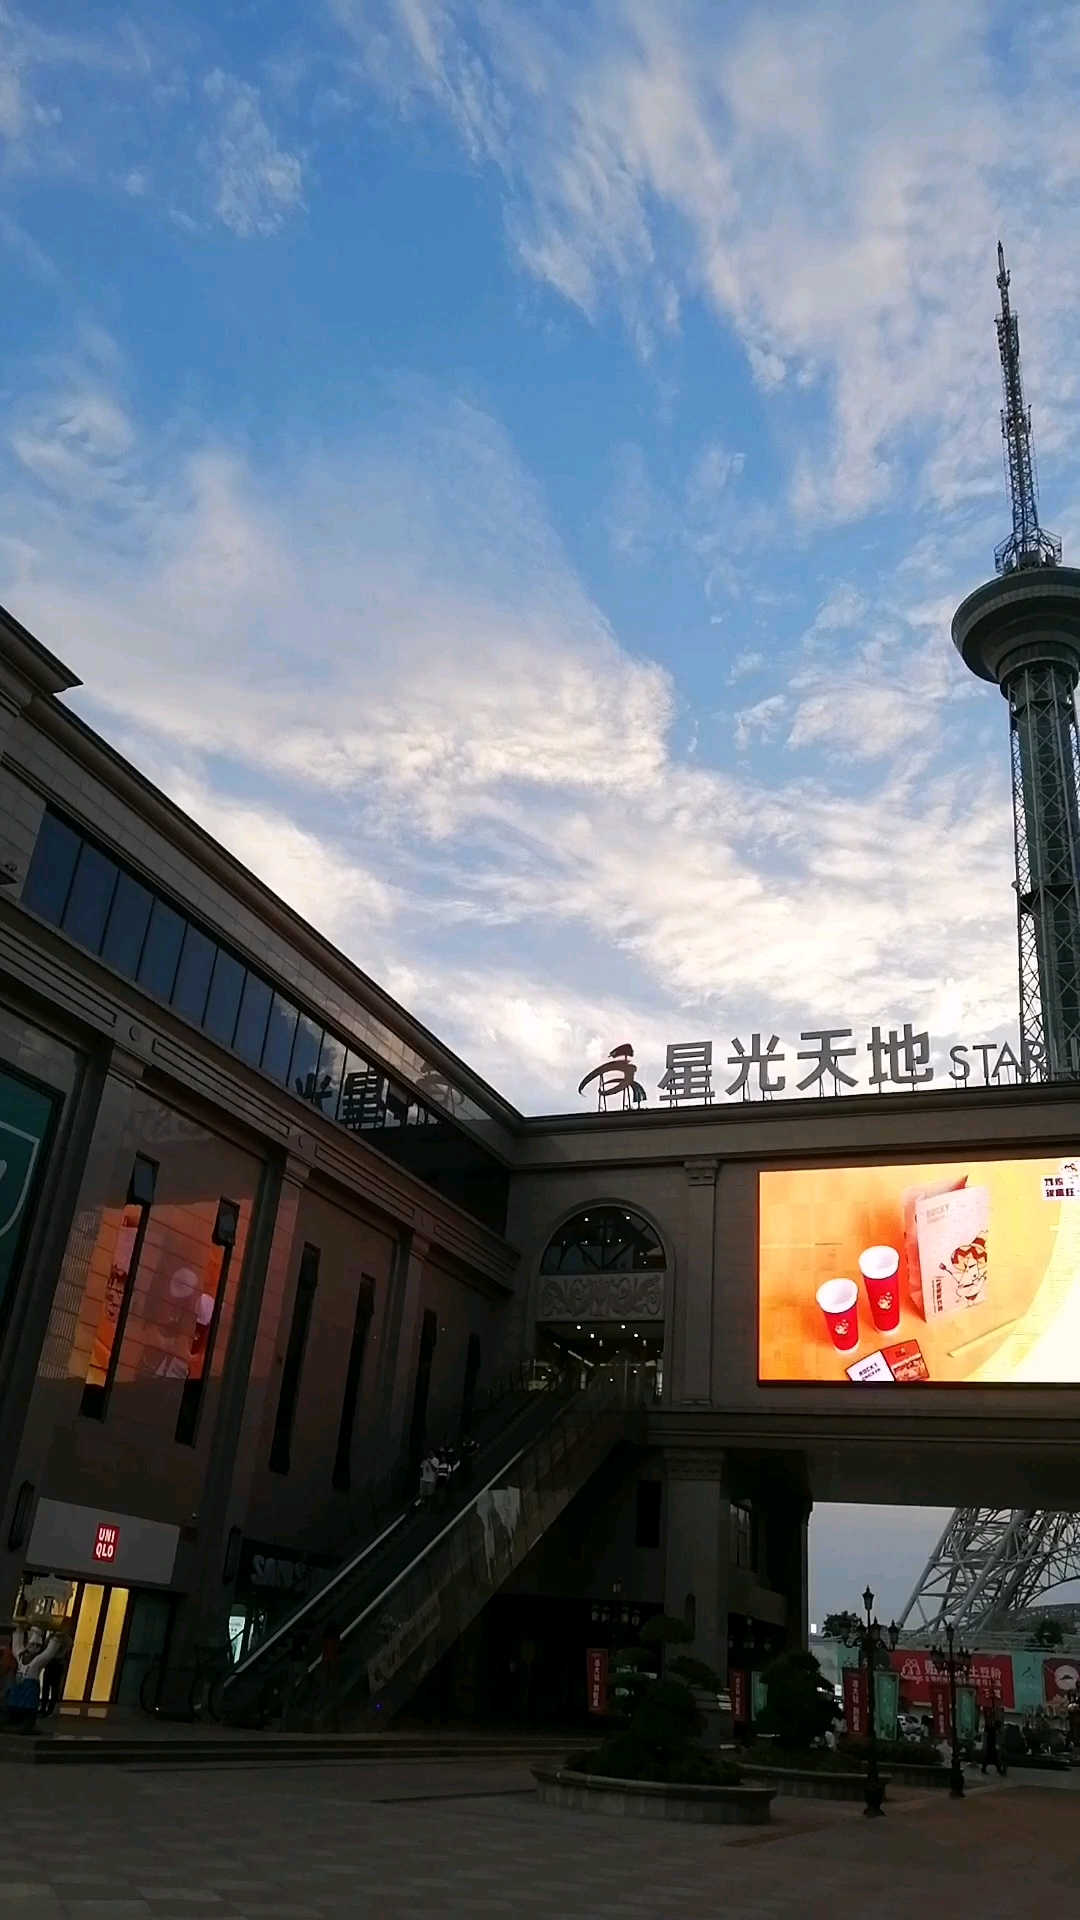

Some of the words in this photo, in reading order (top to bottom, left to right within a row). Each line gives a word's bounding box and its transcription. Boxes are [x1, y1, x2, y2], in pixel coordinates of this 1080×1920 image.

[658, 1024, 934, 1101] 星光天地
[98, 1527, 116, 1543] UNI
[95, 1542, 114, 1559] QLO
